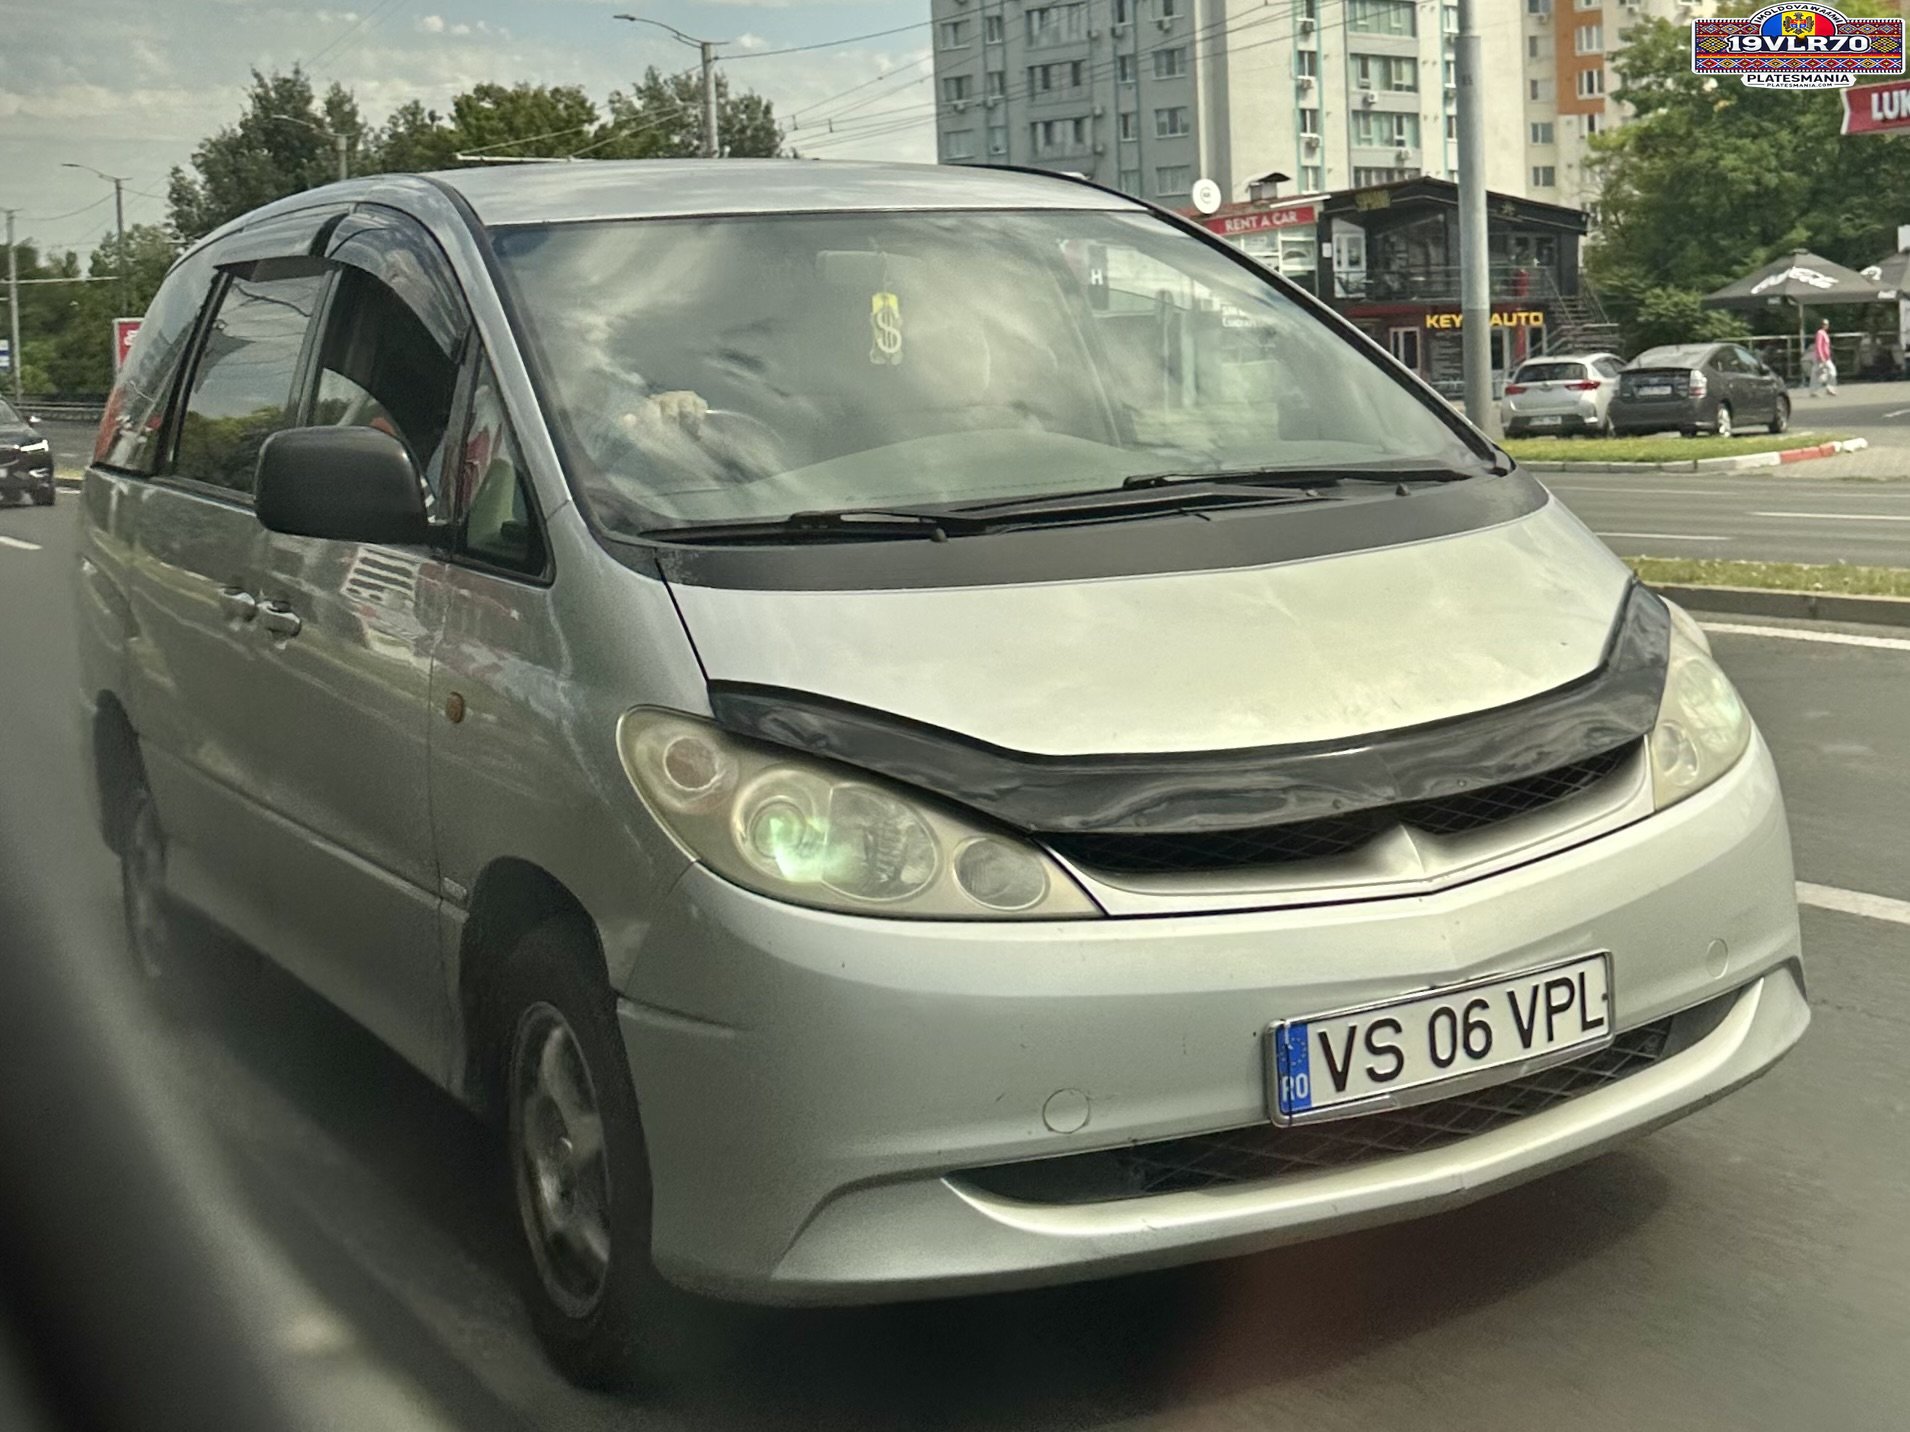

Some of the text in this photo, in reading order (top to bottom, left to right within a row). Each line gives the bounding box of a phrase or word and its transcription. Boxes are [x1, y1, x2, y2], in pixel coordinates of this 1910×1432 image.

[1224, 210, 1297, 233] RENT A CAR
[1489, 311, 1544, 327] AUTO
[1316, 971, 1605, 1093] VS 06 VPL
[1281, 1072, 1309, 1102] RO
